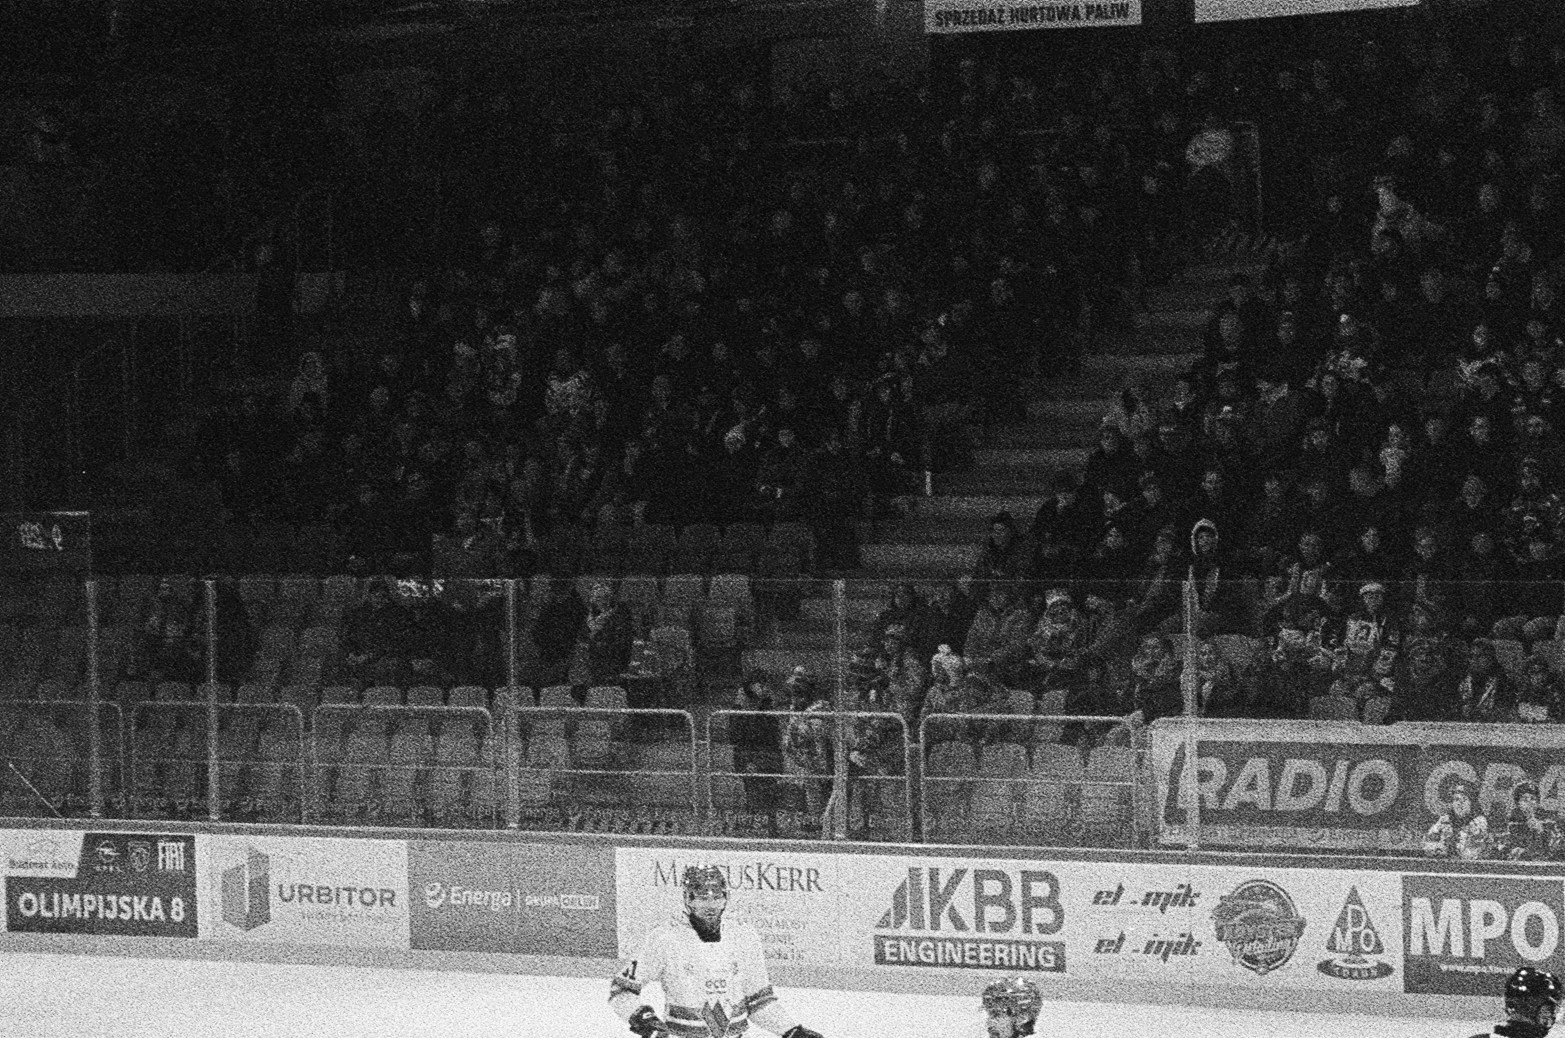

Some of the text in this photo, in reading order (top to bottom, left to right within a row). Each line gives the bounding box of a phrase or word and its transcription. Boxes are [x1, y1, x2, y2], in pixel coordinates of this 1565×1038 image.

[1009, 5, 1081, 23] HURTOWA
[1178, 757, 1399, 816] RADIO
[18, 892, 185, 922] OLIMPIJSKA 8
[278, 884, 396, 907] URBITOR
[451, 886, 511, 911] Energa
[1410, 897, 1559, 962] MPO
[884, 941, 1056, 968] ENGINEERING
